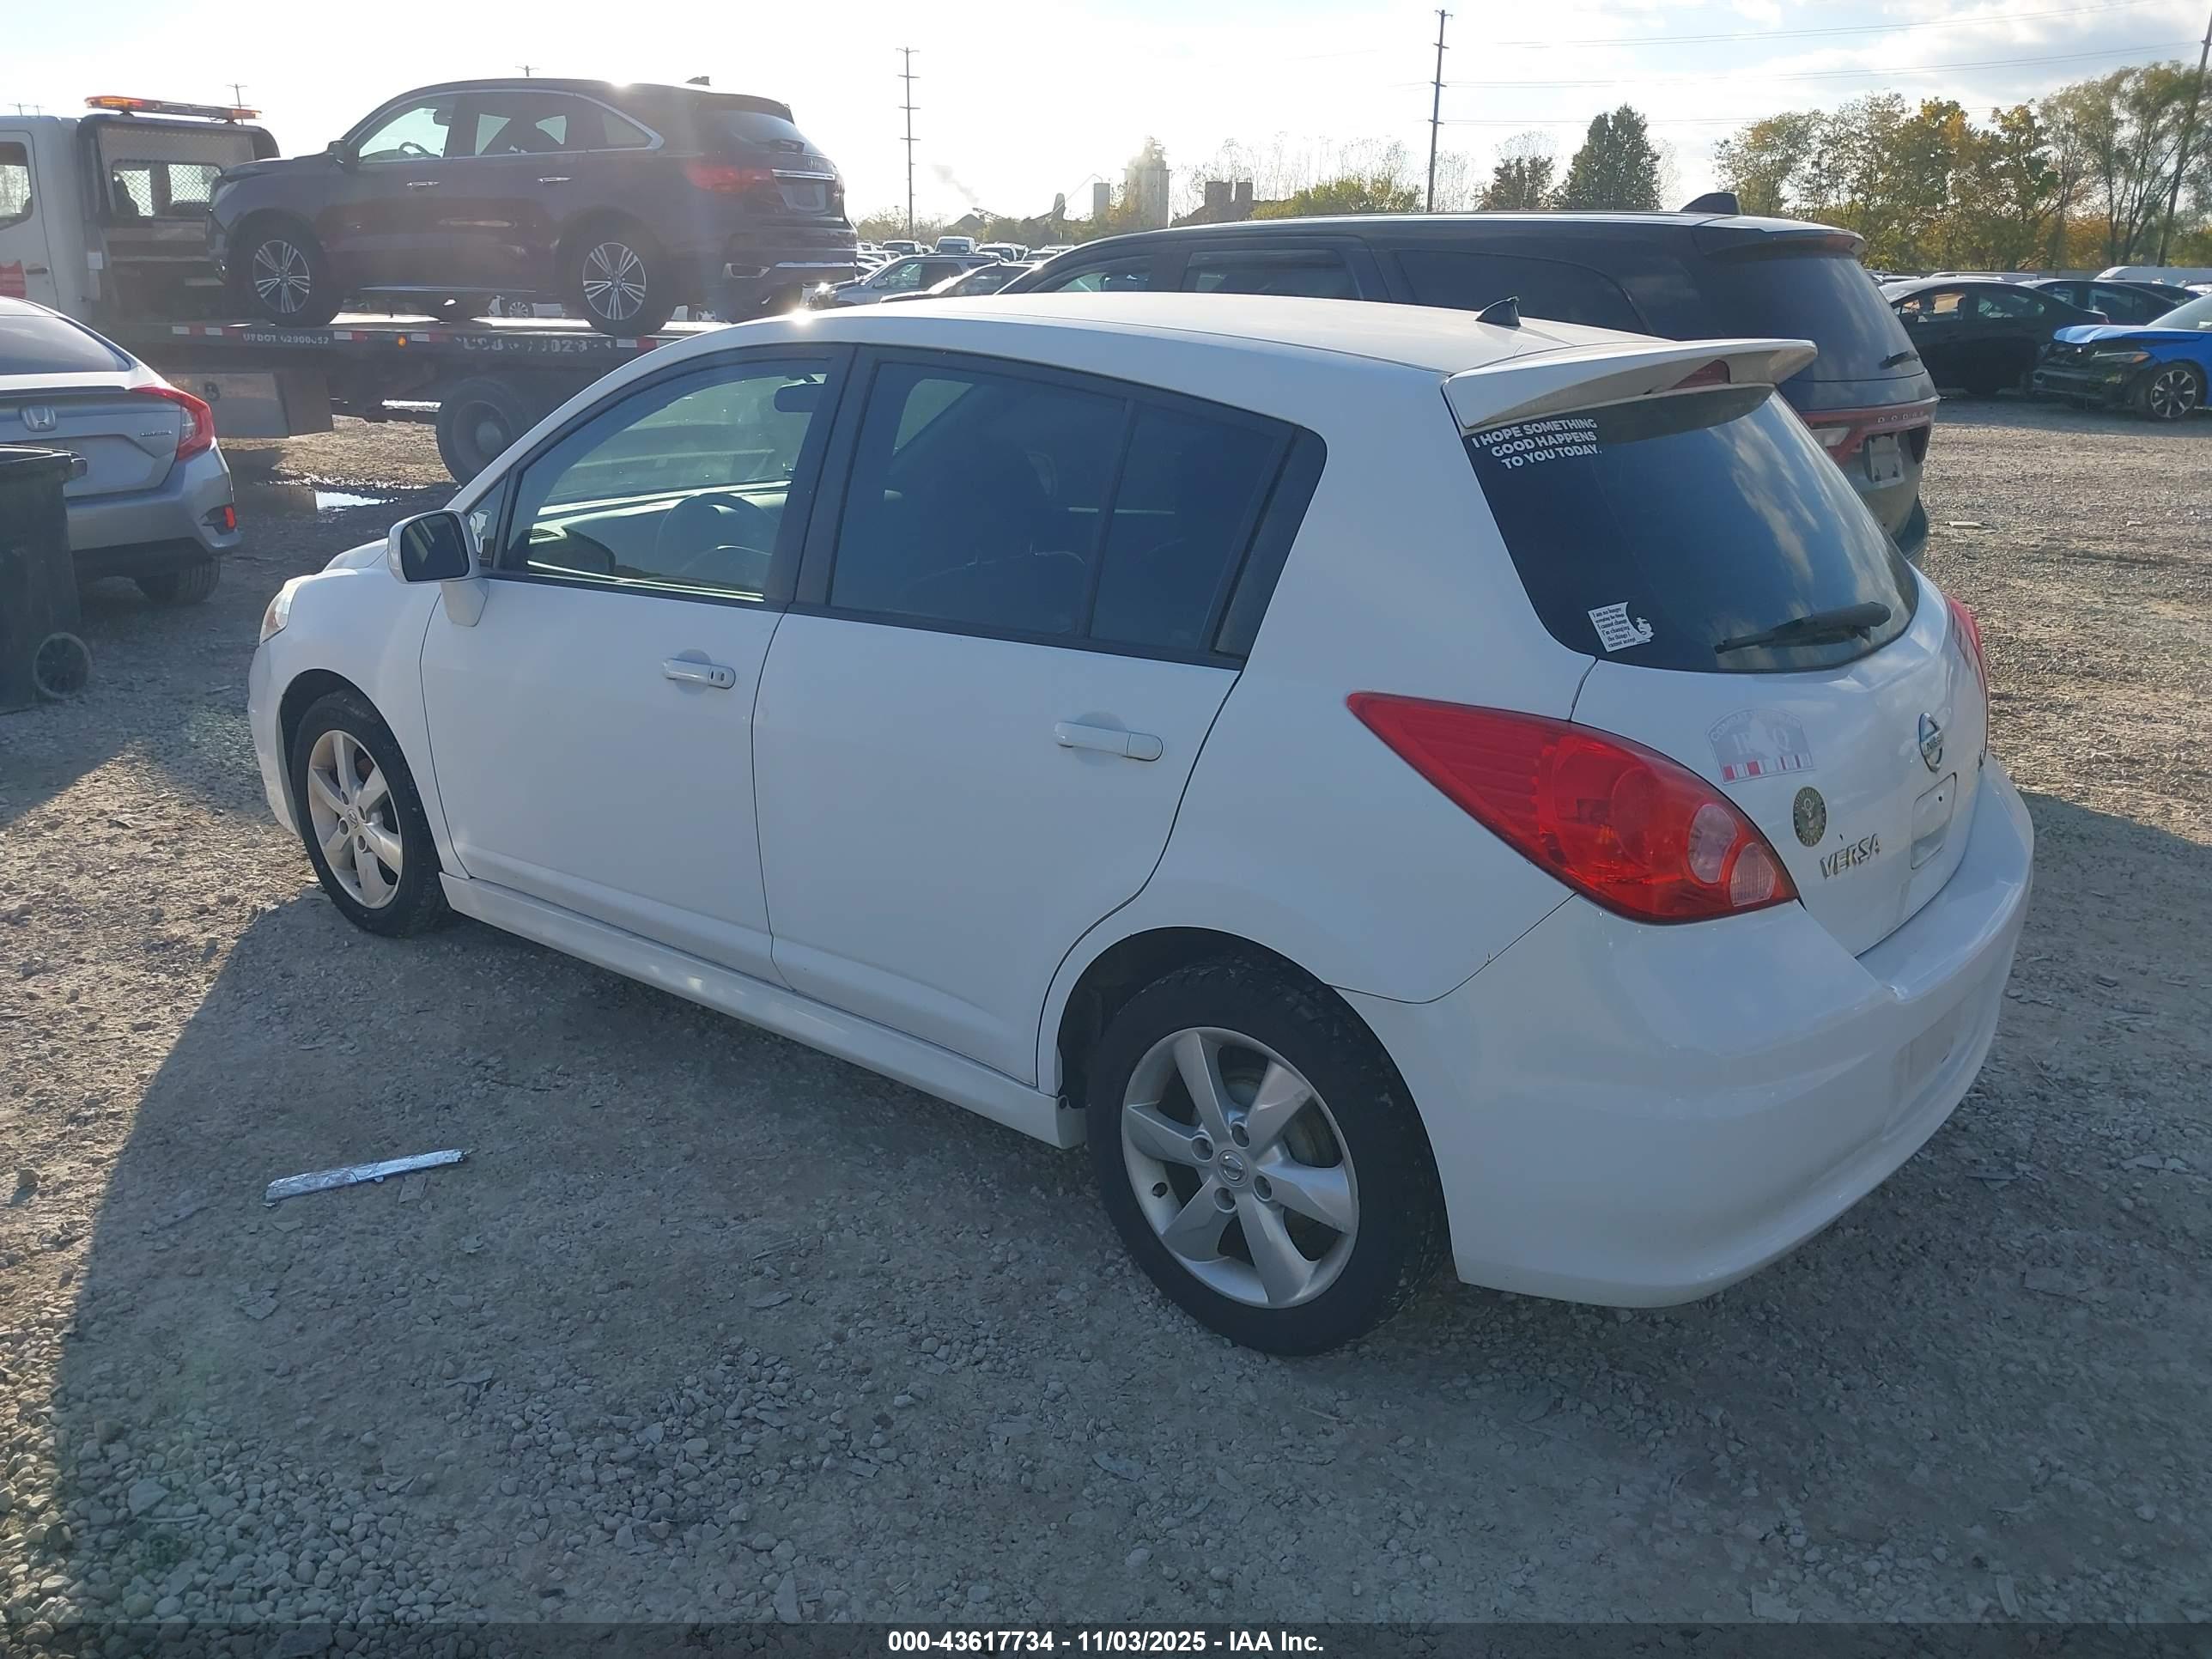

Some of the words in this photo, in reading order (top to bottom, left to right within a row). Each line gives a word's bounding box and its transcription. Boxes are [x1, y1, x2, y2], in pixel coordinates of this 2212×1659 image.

[1471, 437, 1480, 448] I
[1480, 426, 1523, 446] HOPE
[1522, 418, 1598, 434] SOMETHING
[1491, 439, 1536, 457] GOOD
[1534, 430, 1597, 447] HAPPENS
[1501, 456, 1524, 470] TO
[1523, 451, 1556, 464] YOU
[1820, 832, 1881, 880] VERSA
